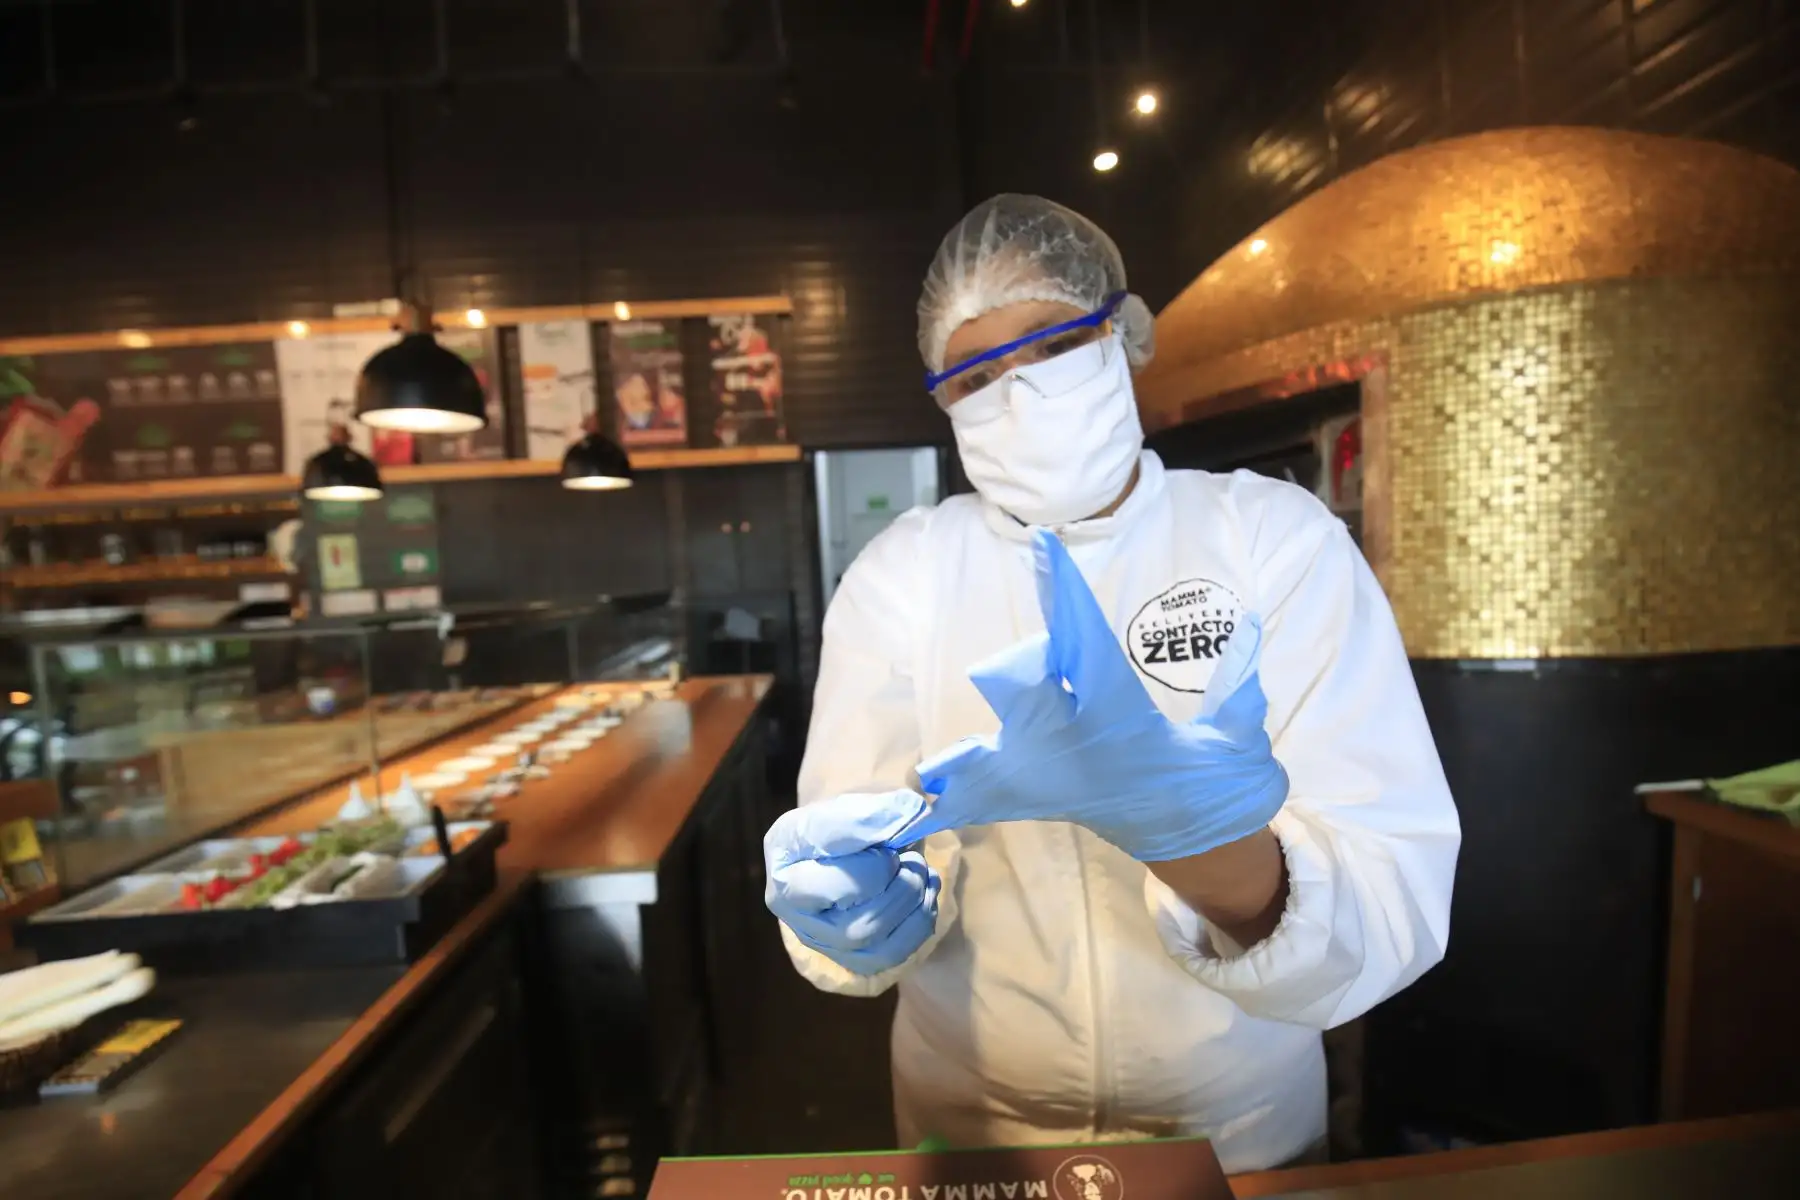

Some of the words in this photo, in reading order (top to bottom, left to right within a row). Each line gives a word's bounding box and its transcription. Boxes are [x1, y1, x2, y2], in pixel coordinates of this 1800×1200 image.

[1160, 588, 1205, 607] MAMMA
[1161, 595, 1208, 612] TOMATO
[1140, 620, 1235, 643] CONTACTO
[920, 1180, 1048, 1200] MAMMA
